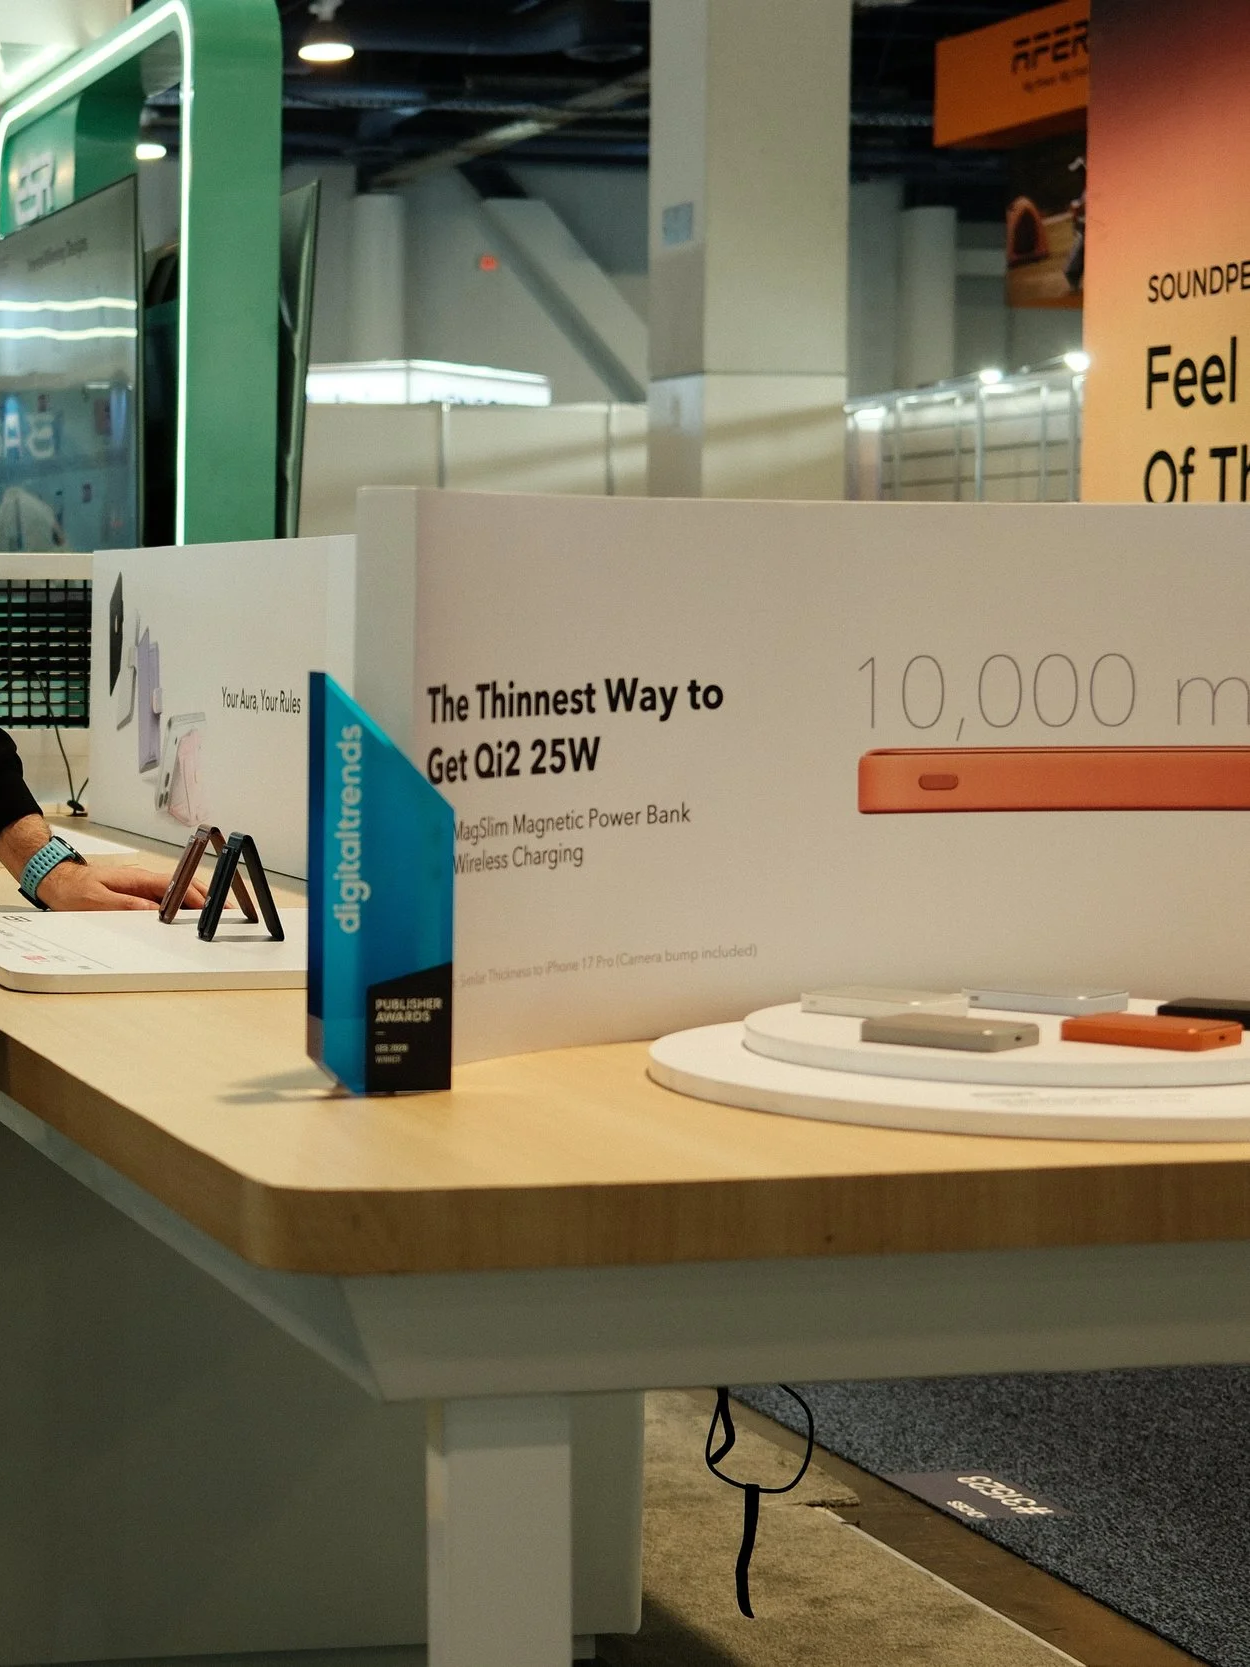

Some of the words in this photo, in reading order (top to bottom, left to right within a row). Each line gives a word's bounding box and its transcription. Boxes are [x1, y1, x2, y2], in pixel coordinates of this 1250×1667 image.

[1146, 336, 1237, 410] Feel
[1144, 446, 1196, 502] Of
[221, 686, 239, 708] Your
[240, 688, 259, 714] Aura,
[260, 689, 278, 712] Your
[279, 689, 301, 714] Rules
[427, 684, 469, 724] The
[475, 680, 597, 720] Thinnest
[604, 677, 679, 722] Way
[687, 679, 725, 710] to
[857, 653, 1136, 742] 10,000
[427, 747, 468, 785] Get
[474, 740, 521, 779] Qi2
[530, 736, 601, 775] 25W
[333, 724, 372, 935] digitaltrends
[453, 816, 509, 846] MagSlim
[512, 809, 584, 839] Magnetic
[588, 807, 641, 828] Power
[646, 801, 691, 824] Bank
[453, 850, 509, 875] Wireless
[511, 843, 584, 870] Charging
[582, 956, 594, 970] 17
[596, 954, 614, 968] Pro
[615, 952, 662, 968] (Camera
[664, 949, 699, 963] bump
[701, 943, 757, 959] included)
[374, 997, 443, 1011] PUBLISHER
[374, 1010, 432, 1023] AWARDS
[957, 1475, 1054, 1515] #31523
